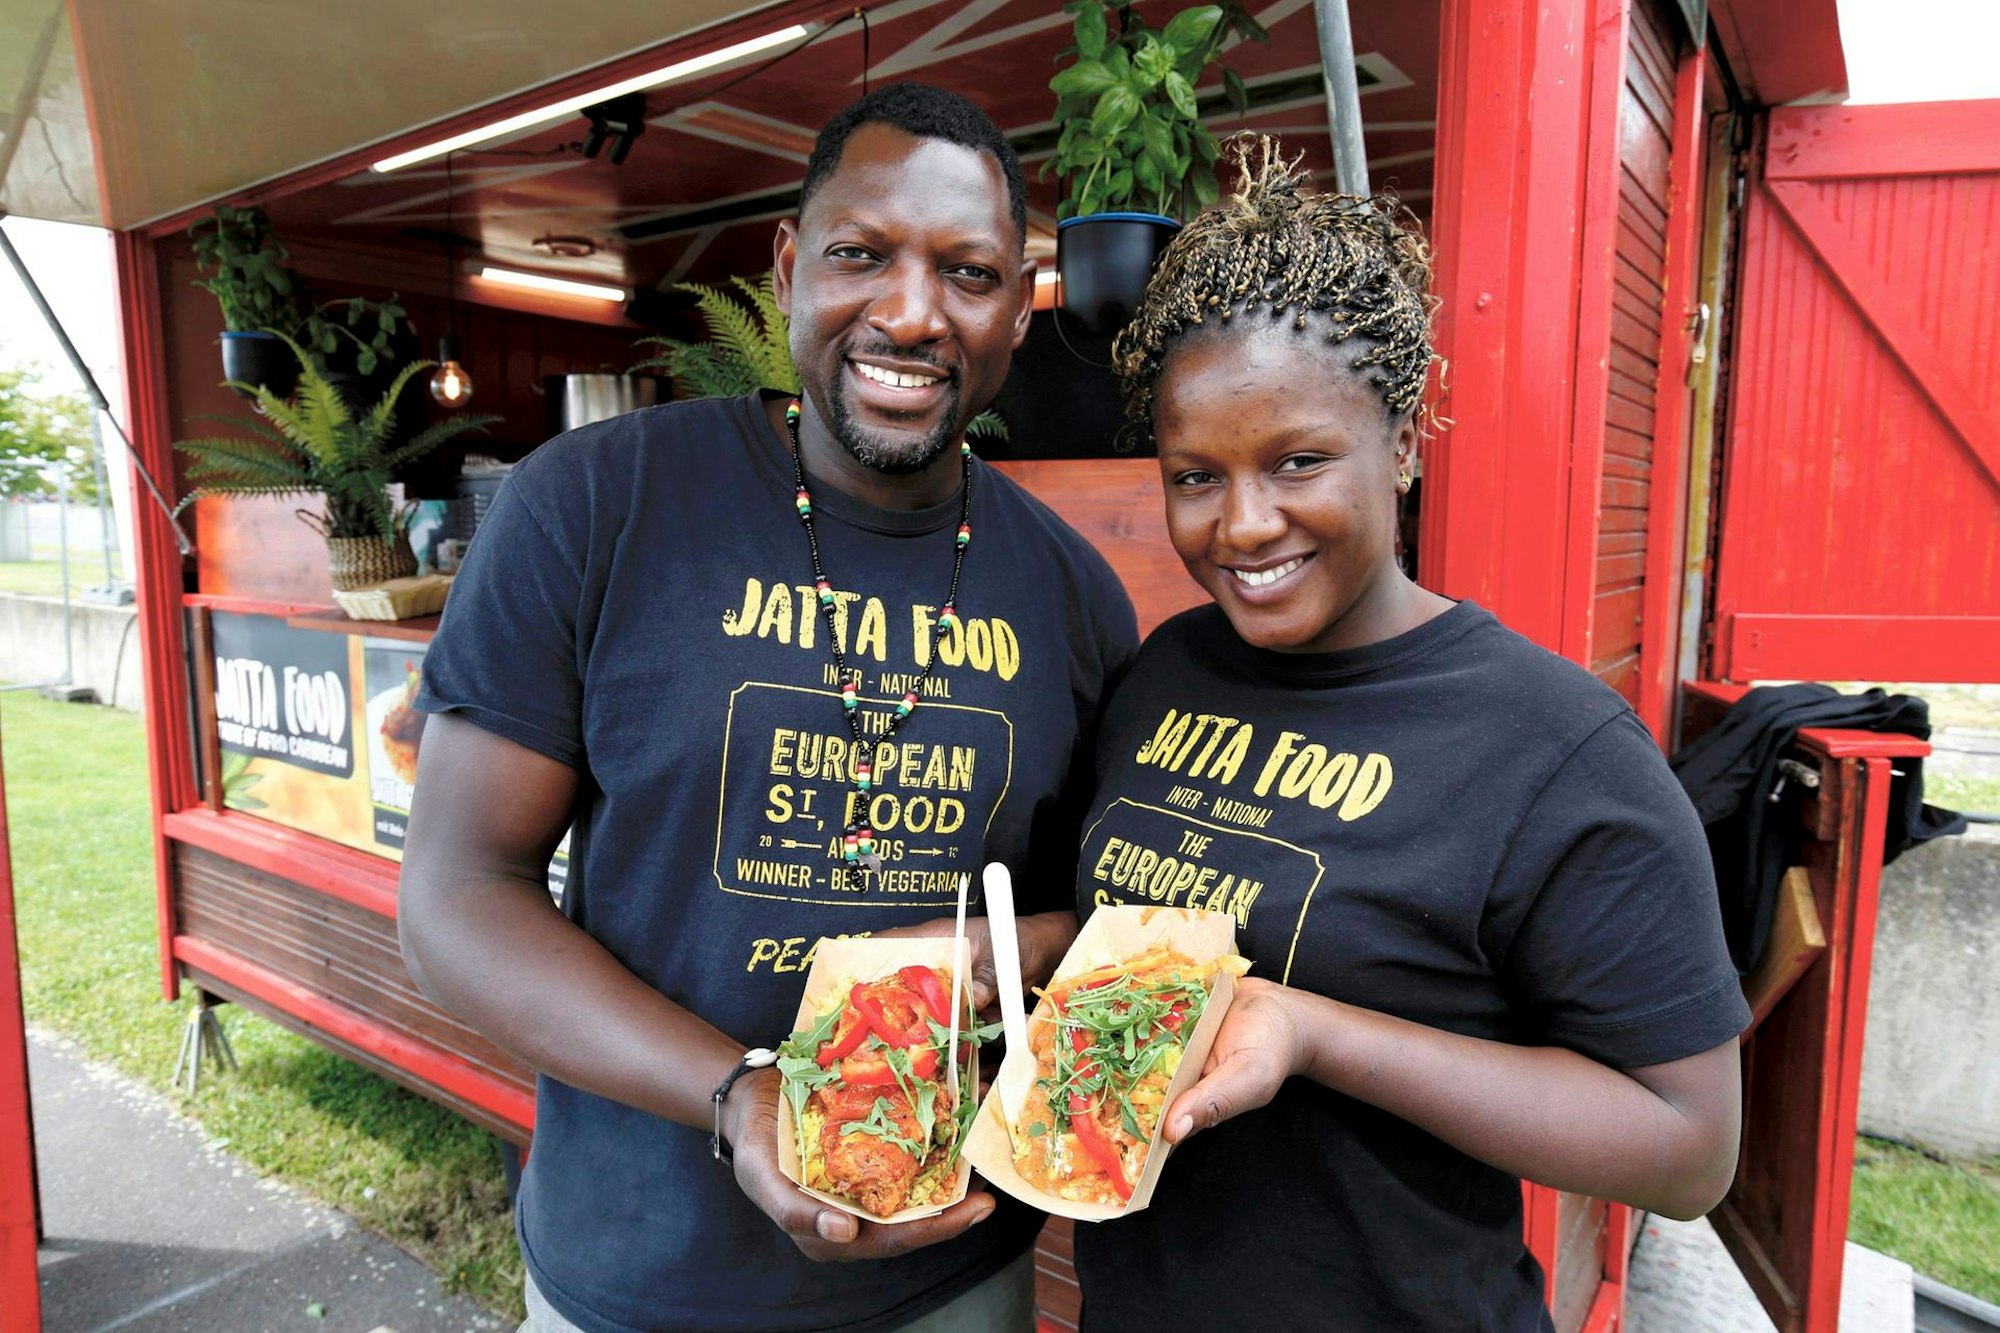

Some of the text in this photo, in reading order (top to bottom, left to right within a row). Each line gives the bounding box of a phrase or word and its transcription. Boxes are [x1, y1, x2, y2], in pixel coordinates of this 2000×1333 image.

[722, 578, 1020, 681] JATTA FOOD
[823, 663, 863, 690] INR
[214, 656, 346, 744] JATTA FOOD
[862, 711, 896, 735] THE
[769, 728, 976, 791] EUROPEAN
[1136, 708, 1393, 822] JATTA FOOD
[1165, 785, 1203, 810] INTER
[1210, 796, 1274, 828] NATIONAL
[759, 835, 773, 847] 20
[827, 836, 904, 861] ARDS
[1178, 830, 1214, 858] THE
[736, 858, 812, 889] WINNER
[831, 868, 872, 892] BEST
[1093, 836, 1264, 930] EUROPEAN
